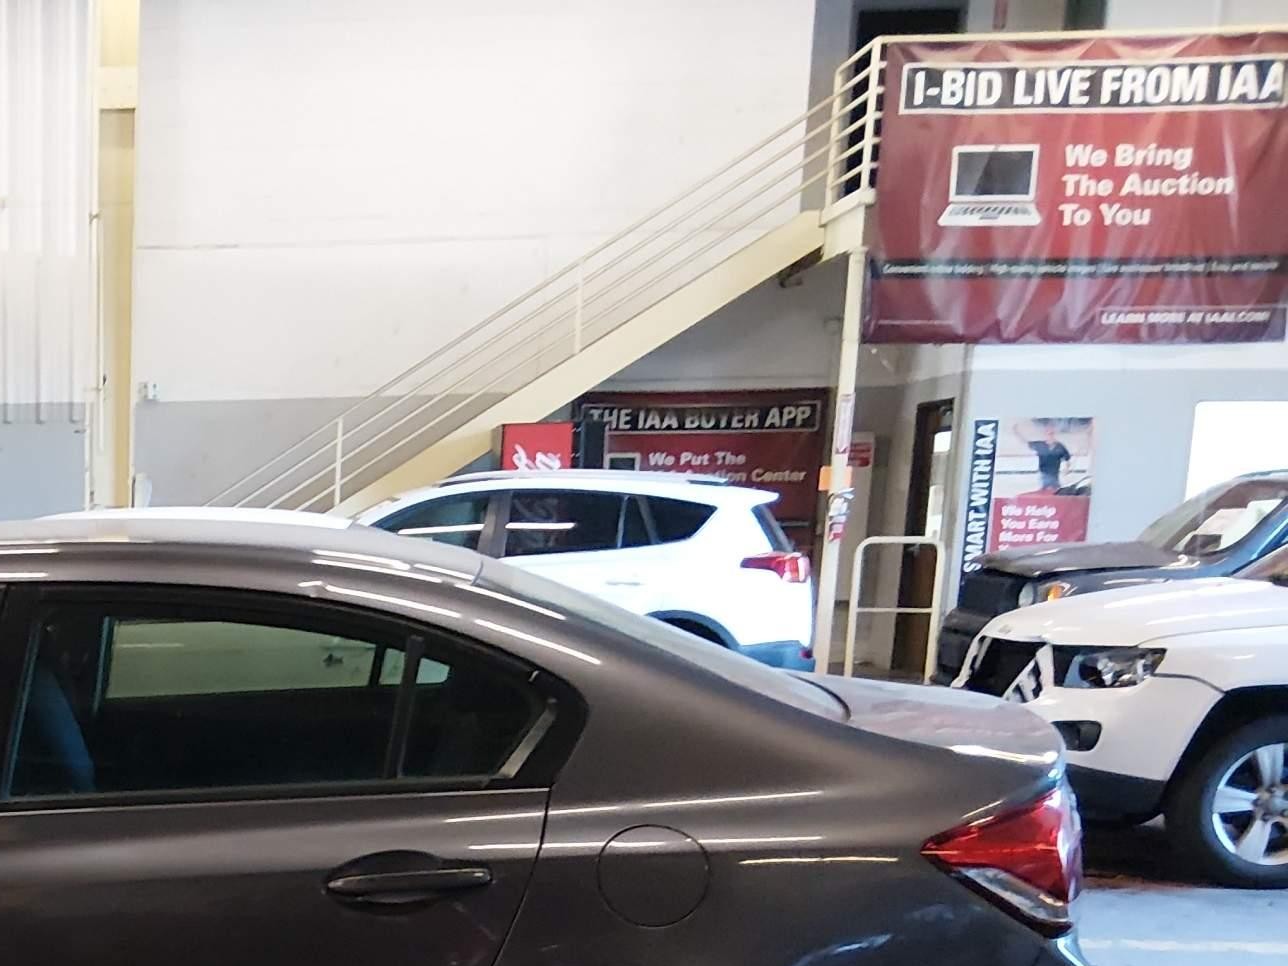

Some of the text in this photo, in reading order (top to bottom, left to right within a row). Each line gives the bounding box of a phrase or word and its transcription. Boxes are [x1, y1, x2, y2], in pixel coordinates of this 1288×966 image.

[913, 60, 1285, 107] I-BID LIVE FROM IAA
[1064, 142, 1194, 171] We Bring
[1062, 171, 1235, 197] The Auction
[1058, 202, 1152, 226] To You
[588, 407, 633, 430] THE
[637, 408, 680, 430] IAA
[764, 405, 812, 428] APP
[648, 450, 747, 466] We Put The
[751, 467, 808, 483] Center
[963, 422, 997, 573] SMART WITH IAA
[1000, 518, 1026, 530] You
[998, 530, 1060, 543] More For
